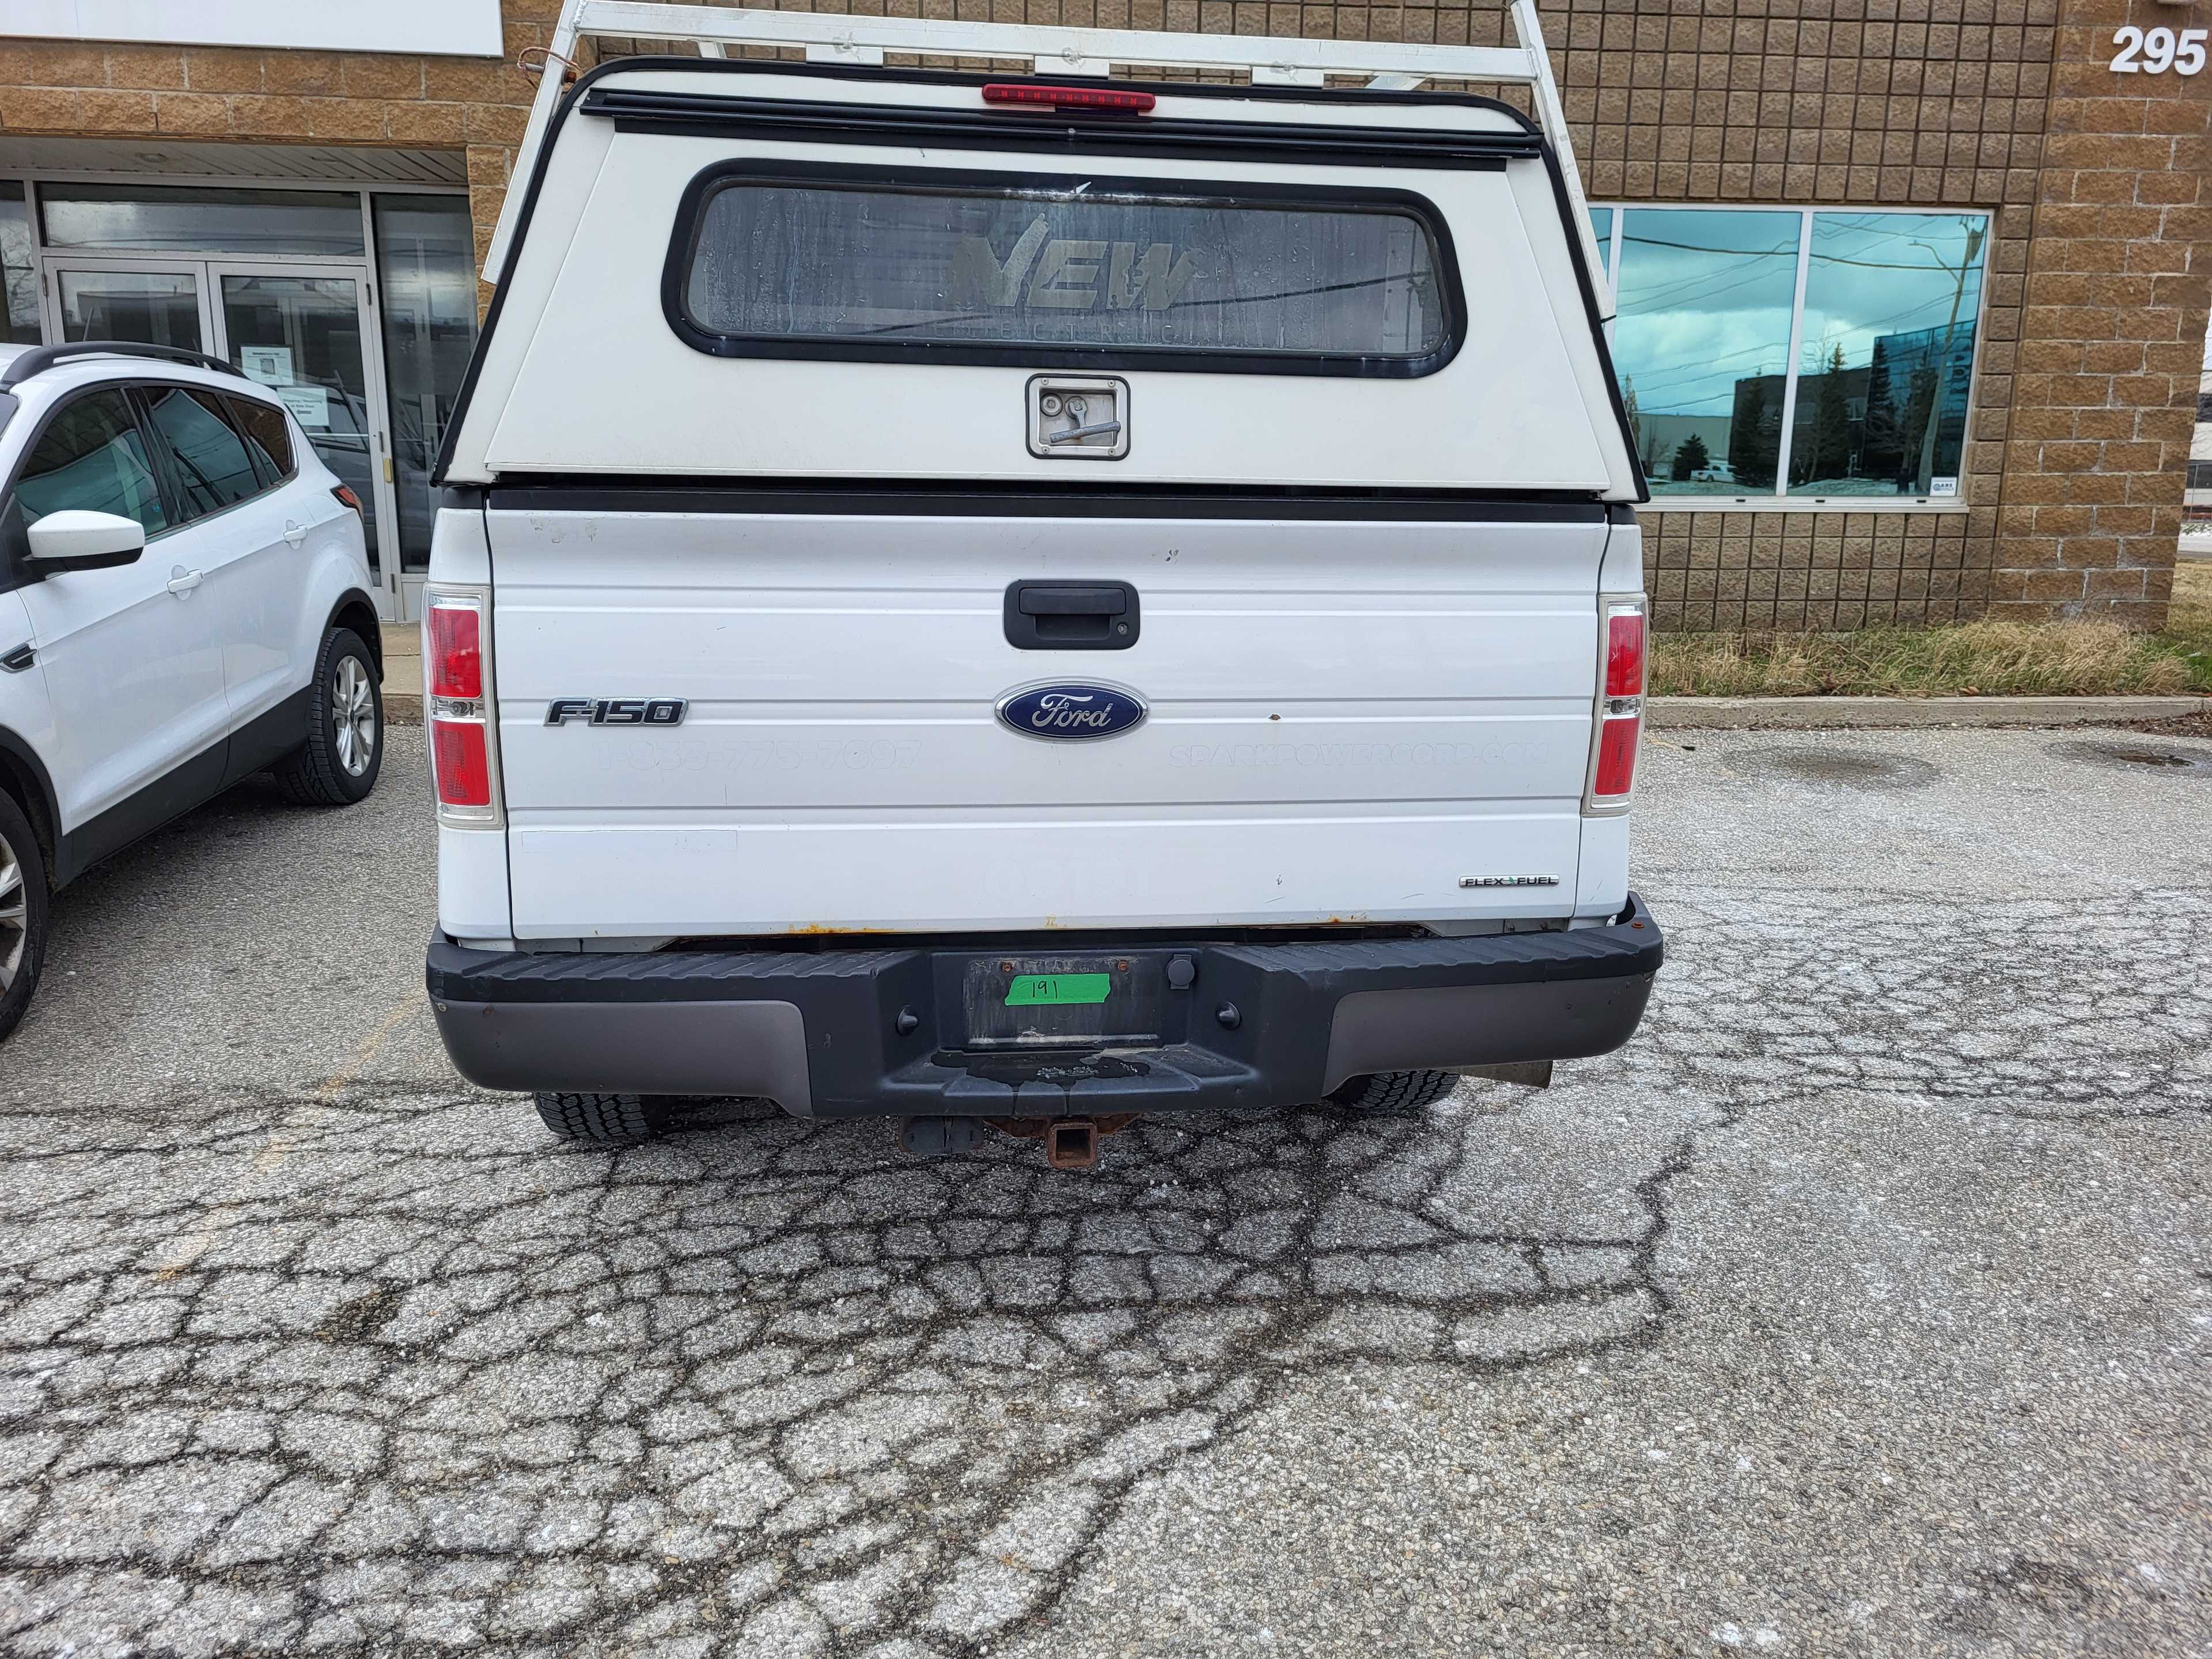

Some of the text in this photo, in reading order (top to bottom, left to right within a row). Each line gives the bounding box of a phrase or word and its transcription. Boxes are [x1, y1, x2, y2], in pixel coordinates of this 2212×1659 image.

[2109, 26, 2208, 75] 295
[543, 696, 688, 726] F-150
[1032, 694, 1113, 727] Ford
[1465, 876, 1555, 887] FLEX FUEL
[1032, 980, 1058, 999] 191
